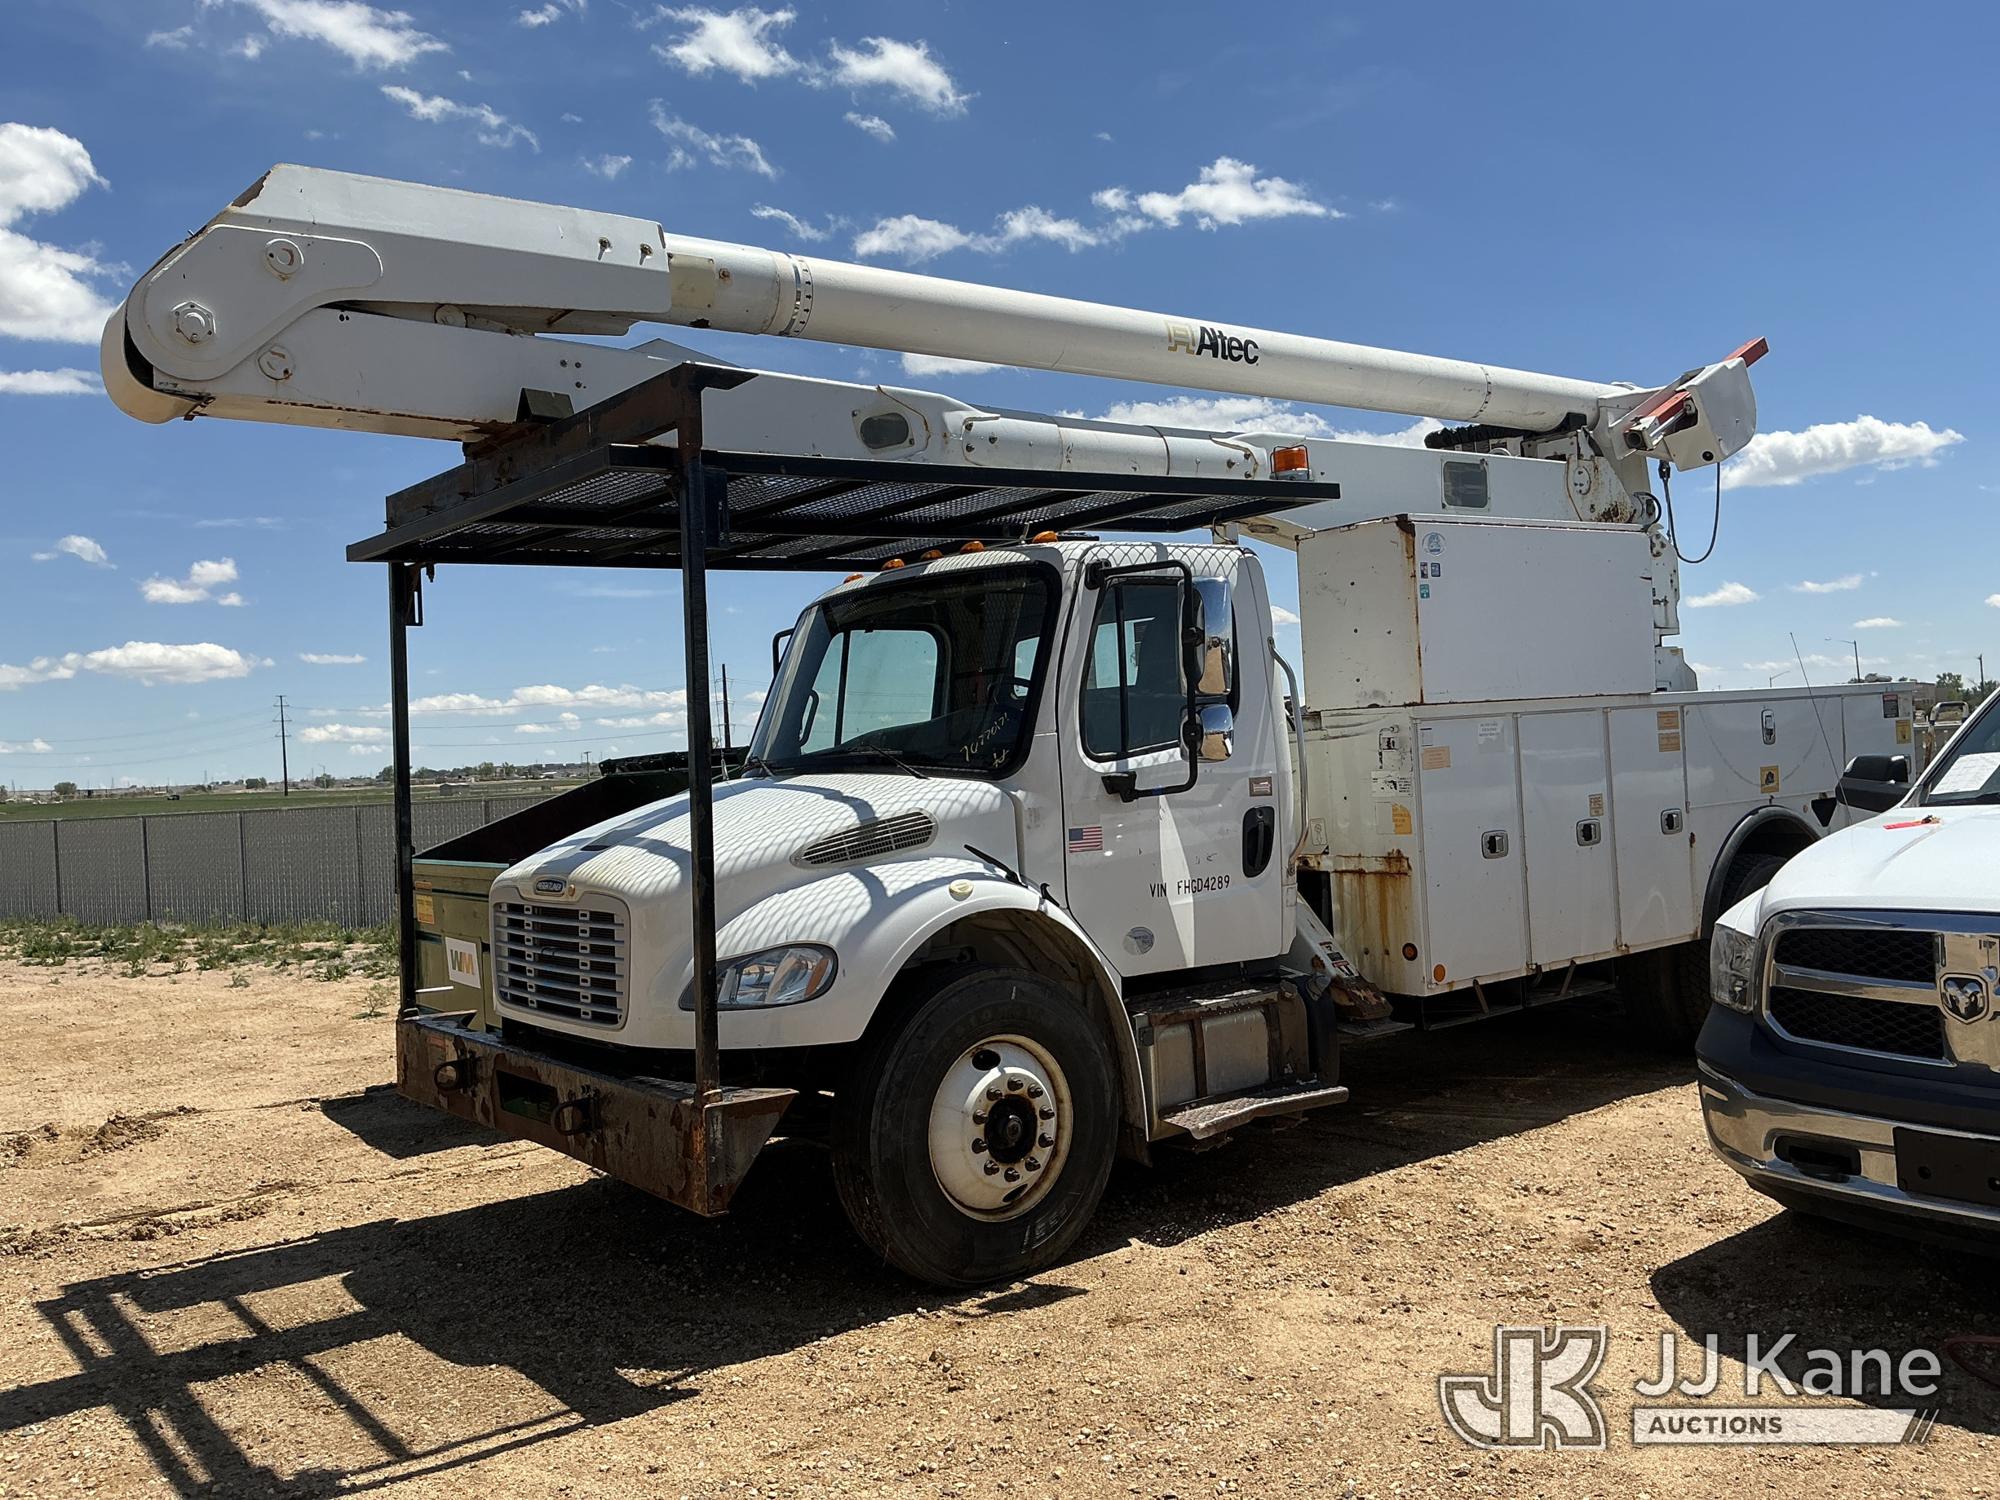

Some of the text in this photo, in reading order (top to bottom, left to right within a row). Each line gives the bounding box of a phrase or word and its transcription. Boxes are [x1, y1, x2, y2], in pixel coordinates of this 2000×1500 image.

[1196, 326, 1259, 365] Altec
[1150, 875, 1230, 898] VIN FHGD4289
[450, 949, 475, 975] WM
